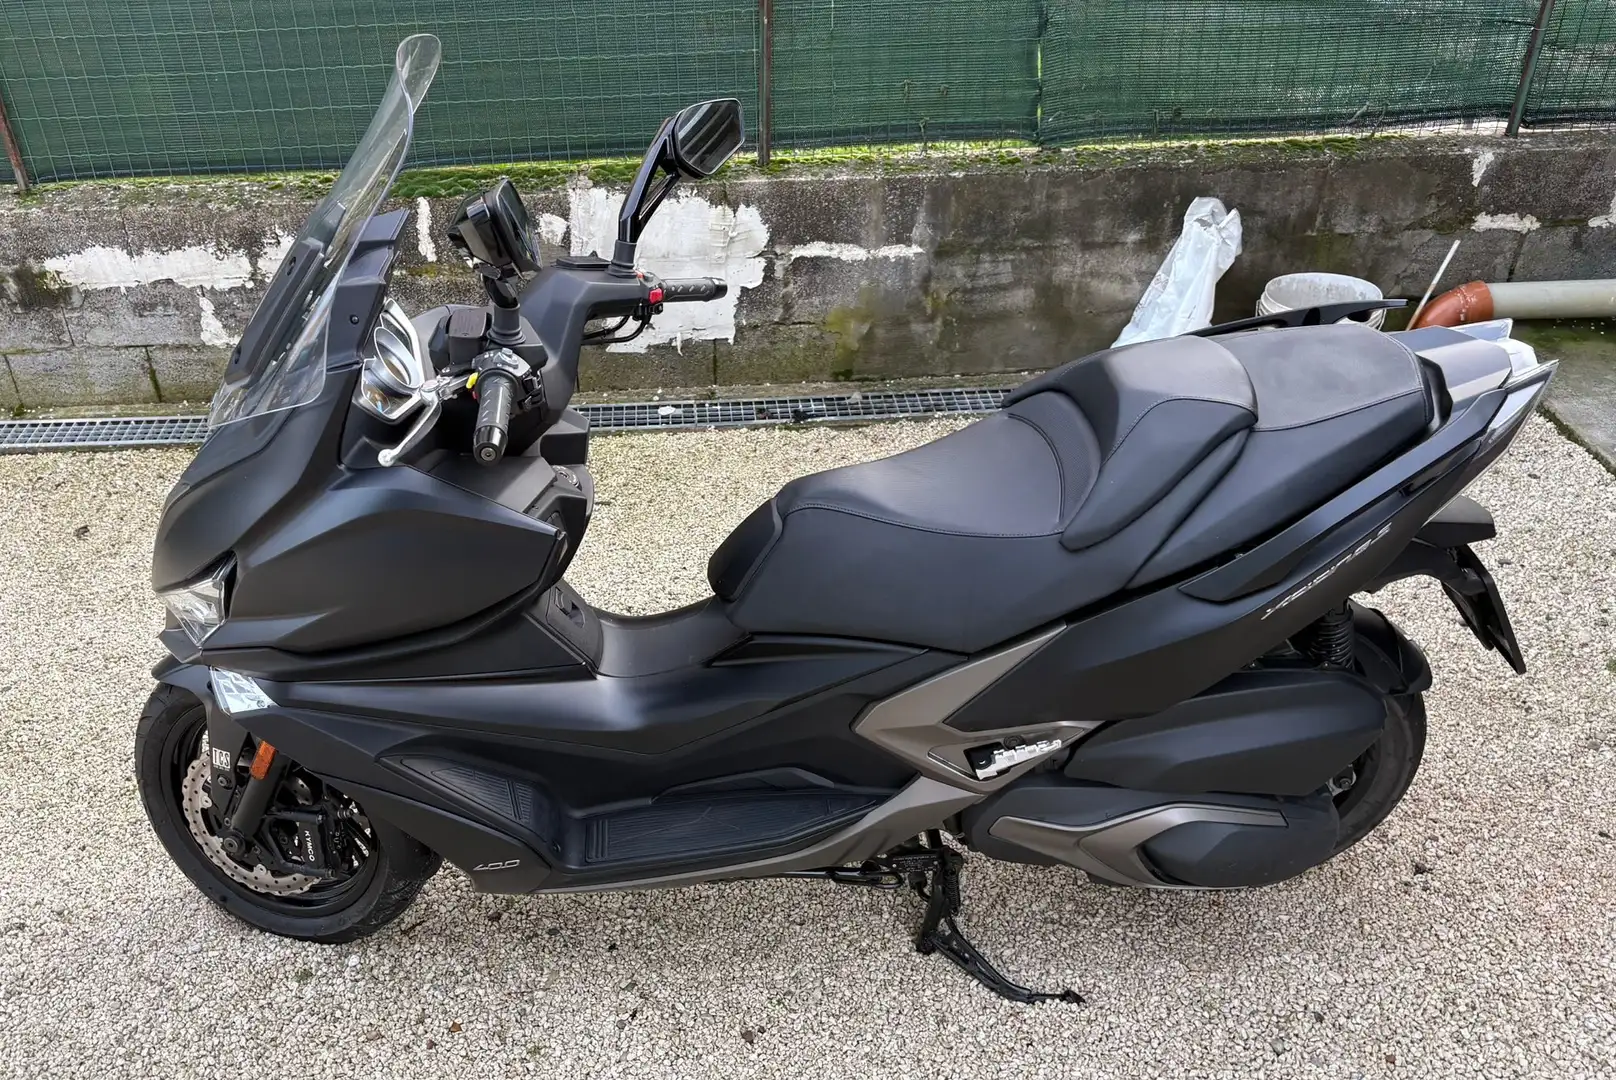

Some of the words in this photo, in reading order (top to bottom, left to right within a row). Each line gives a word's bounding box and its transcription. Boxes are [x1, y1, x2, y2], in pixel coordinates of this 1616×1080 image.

[213, 749, 230, 767] TCS
[304, 830, 316, 862] KYMCO
[473, 859, 520, 871] 400
